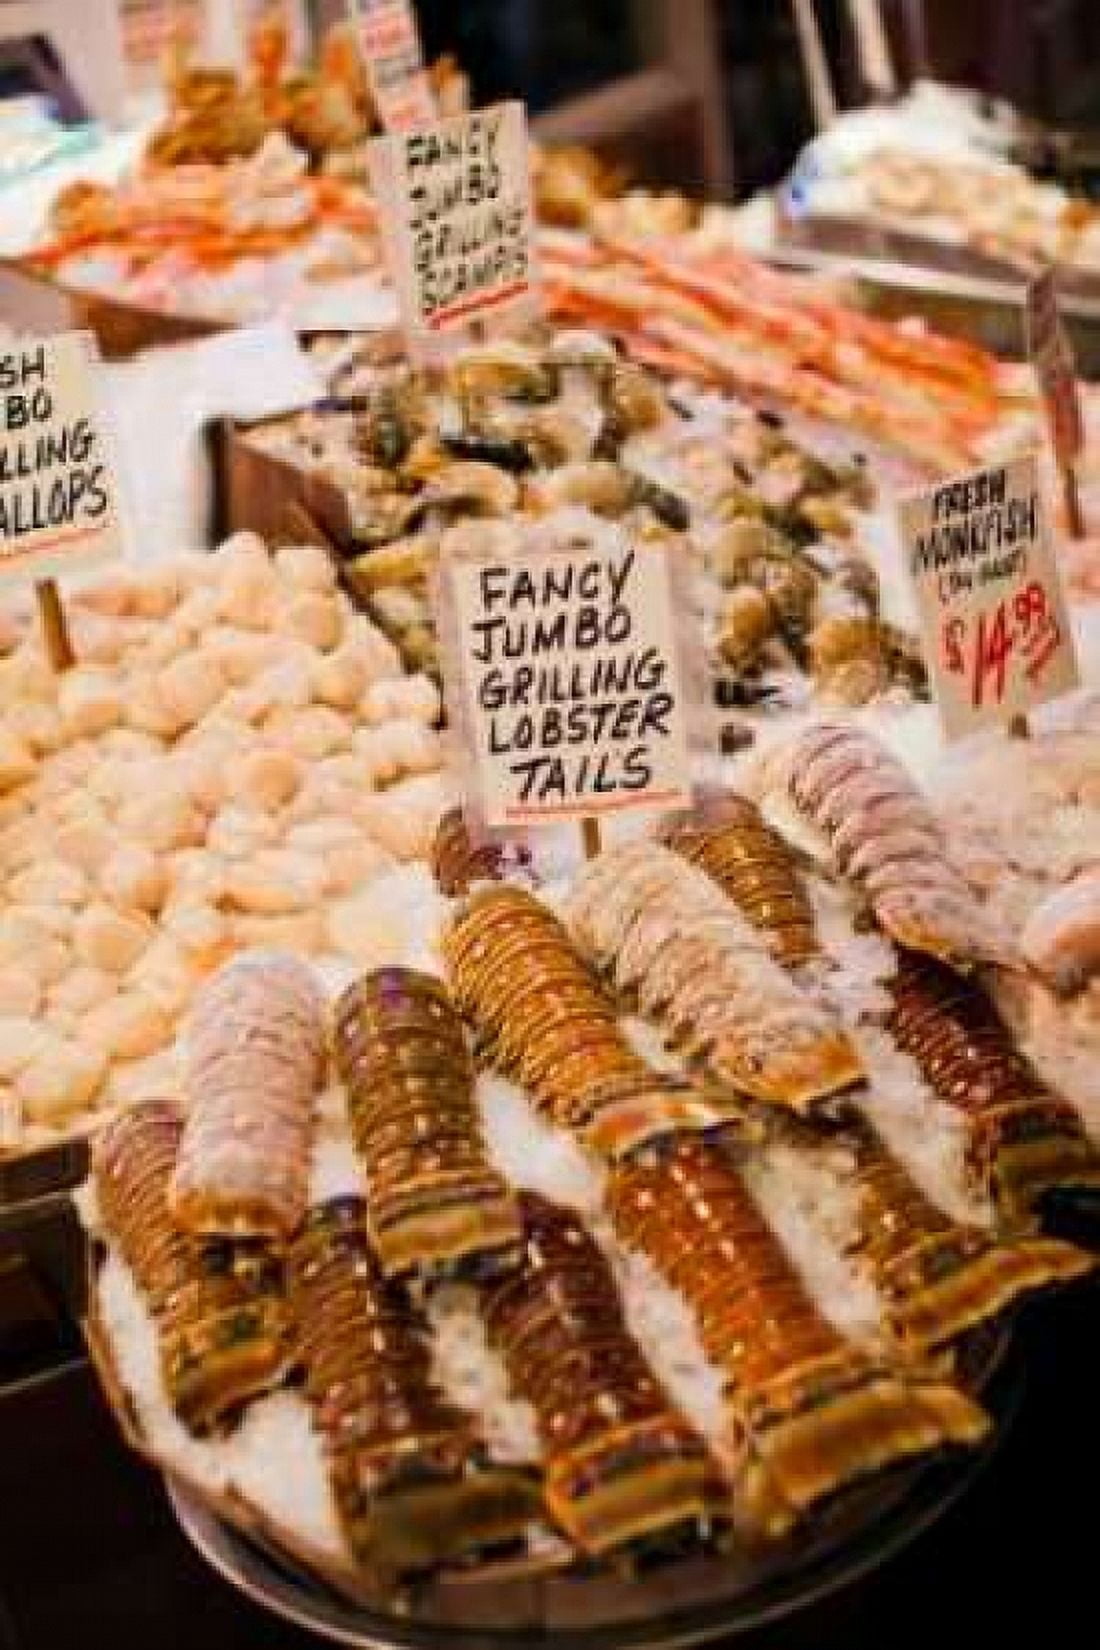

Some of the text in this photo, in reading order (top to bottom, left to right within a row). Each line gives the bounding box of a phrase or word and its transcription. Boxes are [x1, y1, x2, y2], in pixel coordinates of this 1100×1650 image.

[406, 114, 500, 168] FANCY
[932, 468, 1005, 520] FRESH
[910, 495, 1037, 576] MONKFISH
[479, 550, 635, 609] FANCY
[471, 604, 632, 664] JUMBO
[478, 646, 667, 712] GRILLING
[488, 692, 675, 756] LOBSTER
[509, 744, 653, 801] TAILS
